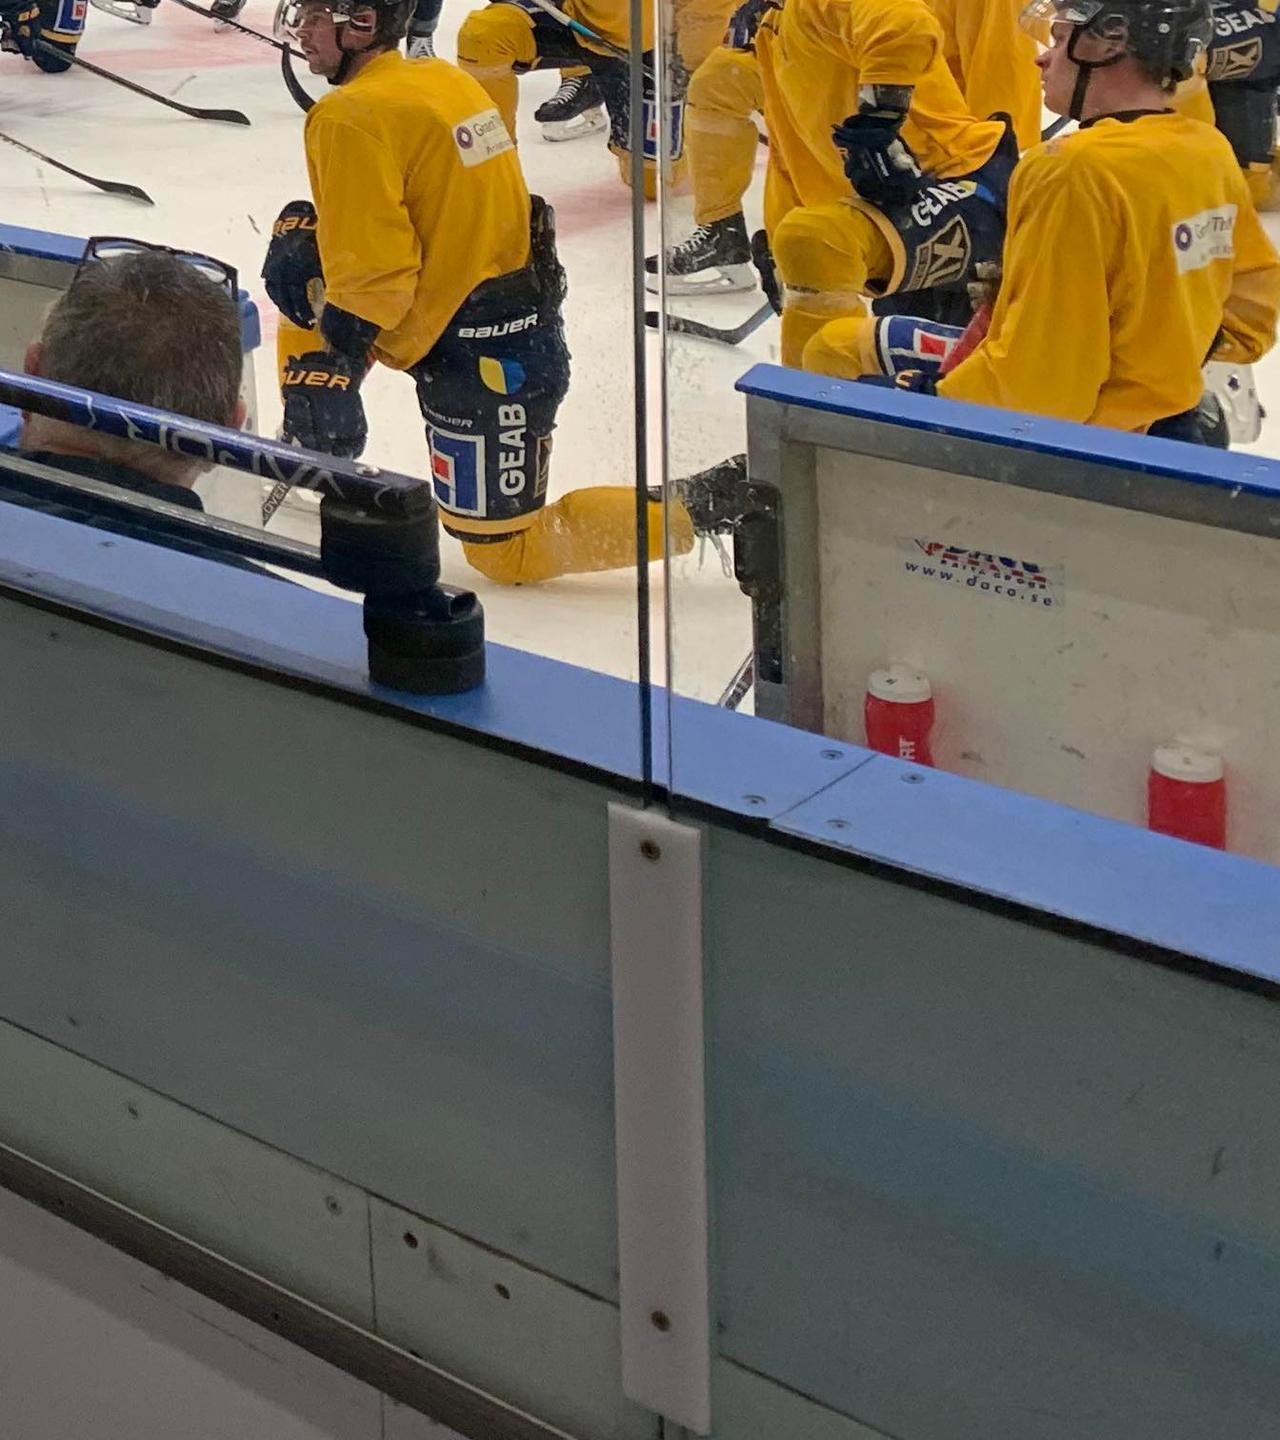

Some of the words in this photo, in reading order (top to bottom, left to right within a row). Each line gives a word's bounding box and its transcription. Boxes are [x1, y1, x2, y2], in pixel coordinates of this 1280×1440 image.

[273, 216, 318, 235] BAU
[458, 313, 539, 339] BAUER
[283, 369, 351, 391] UER
[498, 402, 528, 497] GEAB
